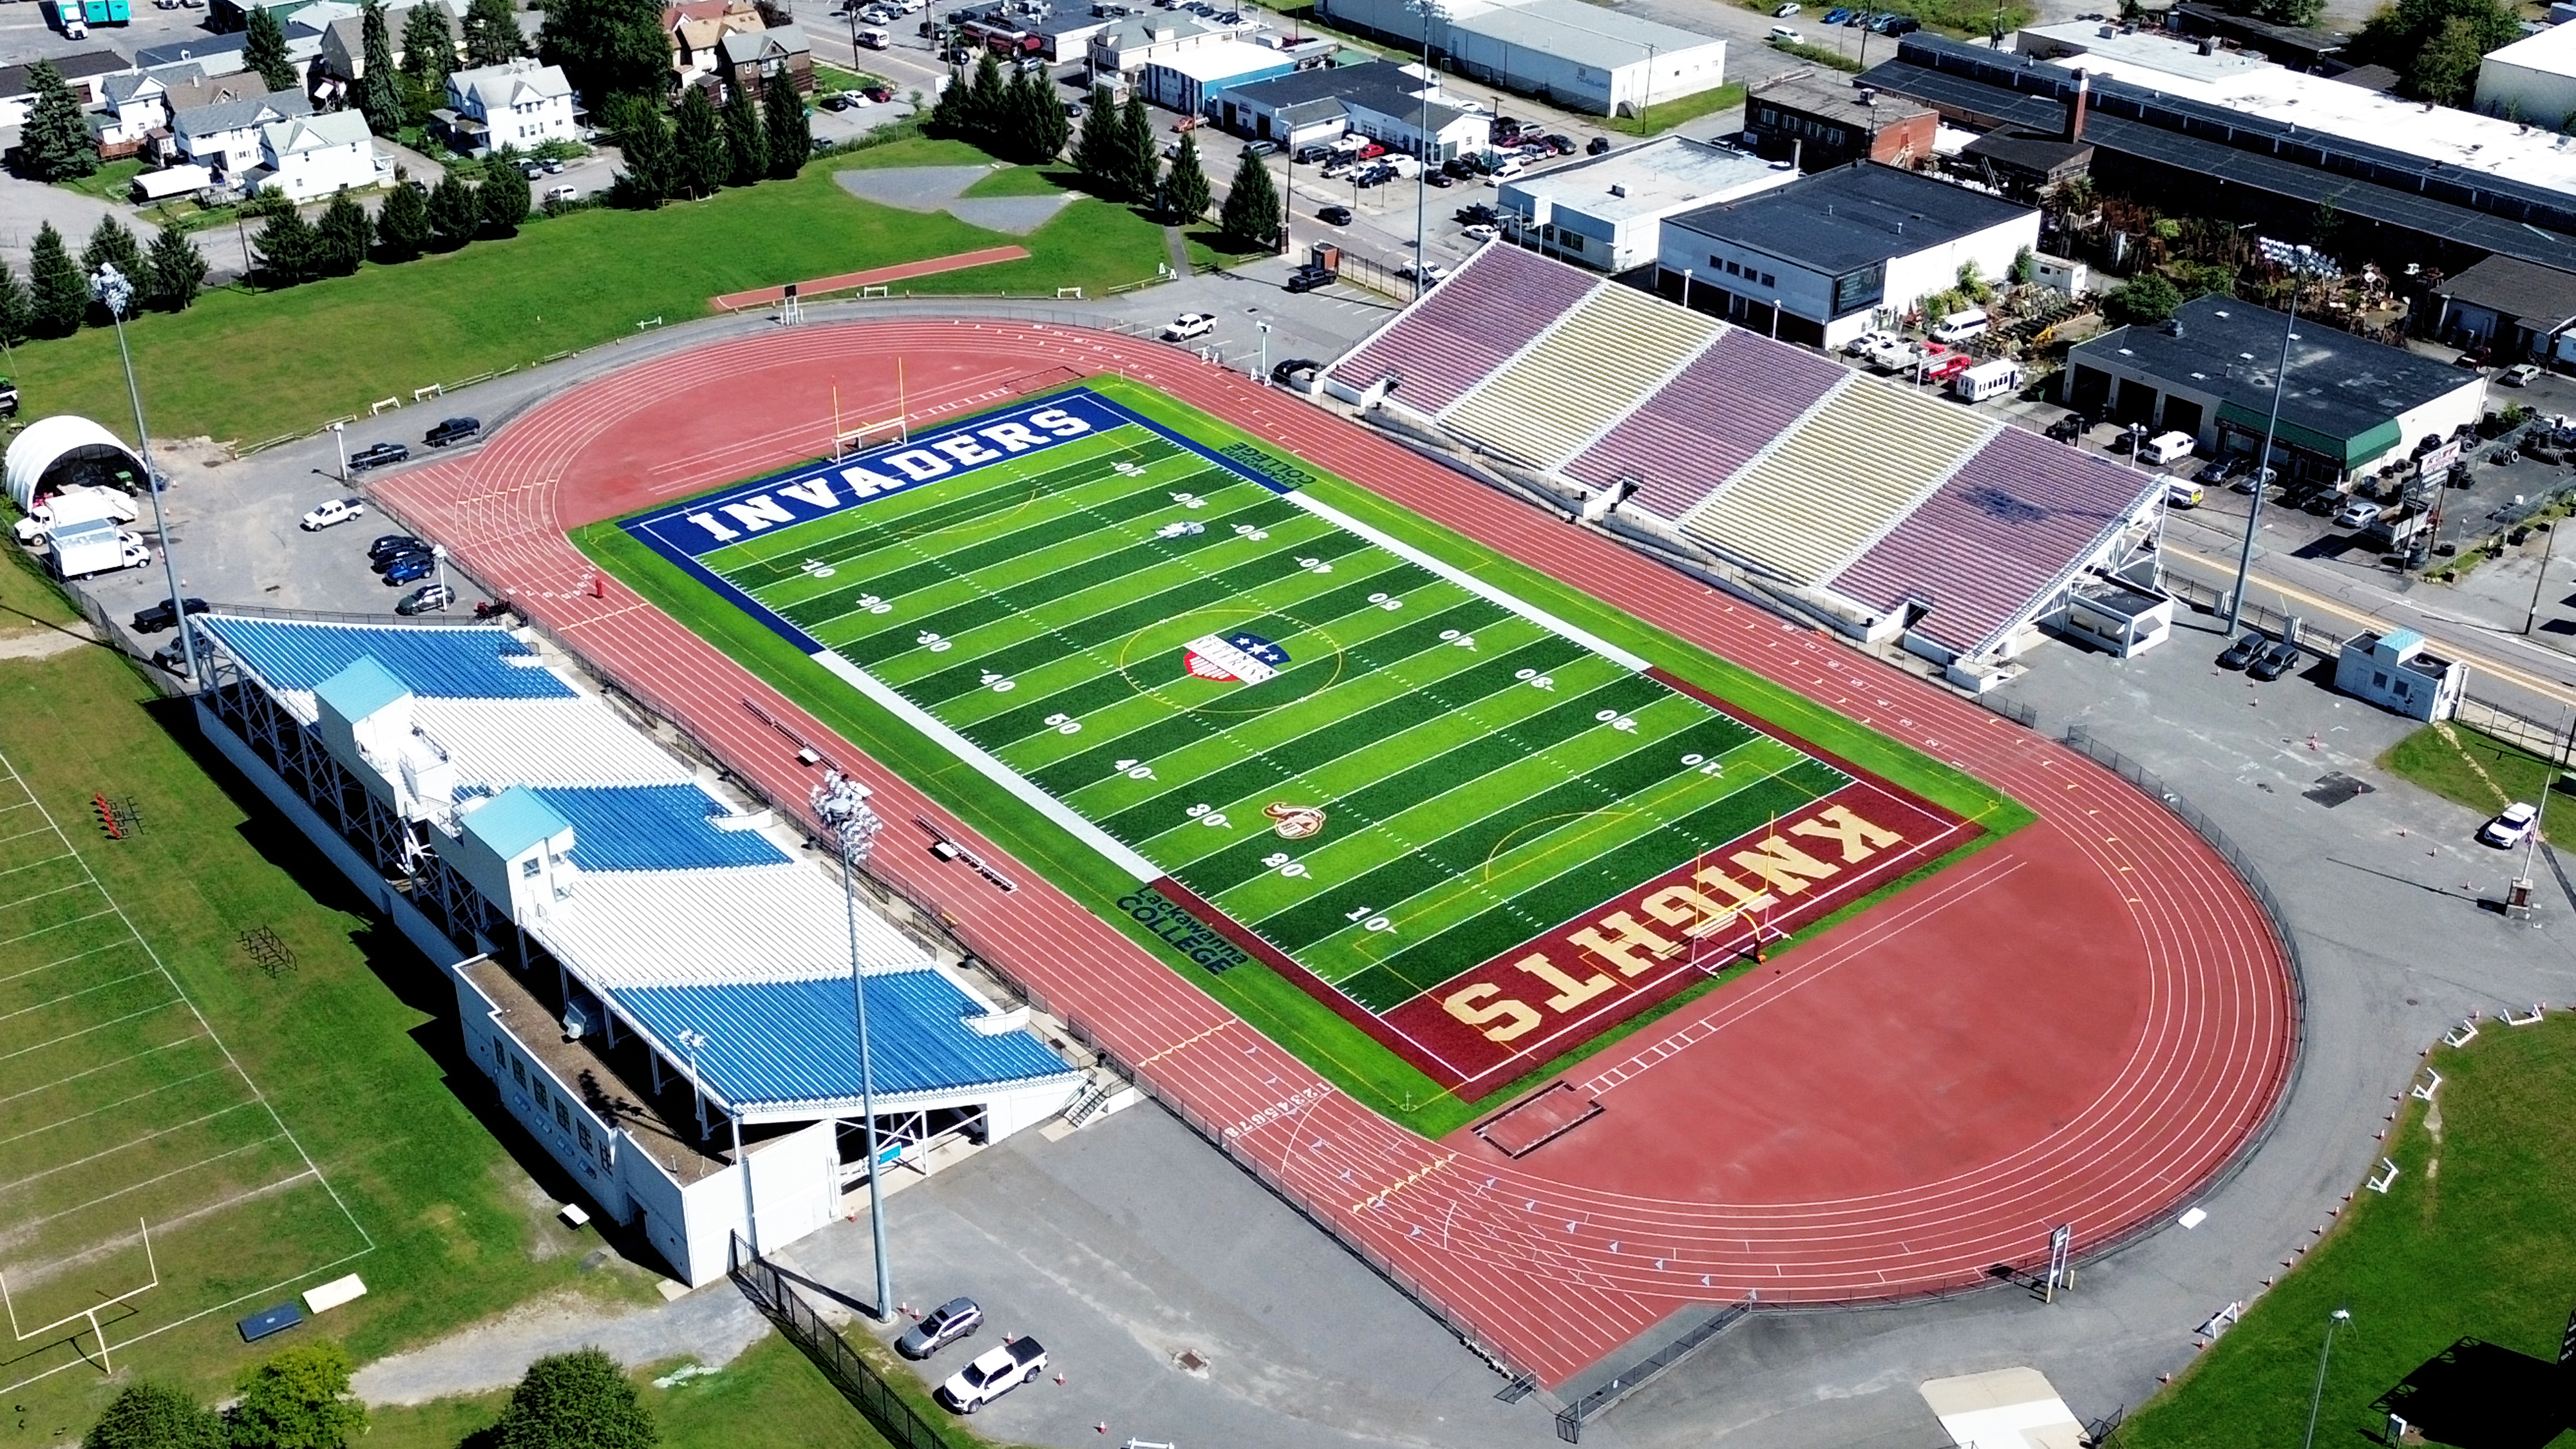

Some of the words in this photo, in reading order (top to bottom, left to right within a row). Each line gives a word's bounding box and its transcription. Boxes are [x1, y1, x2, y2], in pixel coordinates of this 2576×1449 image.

[1115, 463, 1146, 477] 10
[1229, 442, 1317, 484] COLLEGE
[687, 410, 1092, 541] INVADERS
[1173, 493, 1208, 509] 20
[1235, 525, 1269, 541] 30
[801, 562, 835, 578] 10
[1300, 558, 1333, 573] 40
[856, 596, 893, 613] 20
[1367, 593, 1403, 611] 50
[917, 634, 952, 652] 30
[1439, 630, 1474, 646] 40
[1206, 636, 1275, 676] SCRANTON
[980, 674, 1015, 692] 40
[1515, 668, 1553, 687] 30
[1044, 713, 1081, 734] 50
[1596, 710, 1638, 730] 20
[1114, 759, 1152, 779] 40
[1681, 754, 1723, 774] 10
[1186, 804, 1226, 826] 30
[1261, 853, 1305, 876] 20
[1135, 886, 1248, 964] Lackawanna
[1345, 907, 1390, 931] 10
[1442, 804, 1904, 1042] KNIGHTS
[1117, 896, 1236, 975] COLLEGE
[1239, 1121, 1253, 1132] 7
[1264, 1107, 1279, 1118] 5
[1276, 1101, 1289, 1111] 4
[1290, 1095, 1305, 1104] 3
[1303, 1088, 1318, 1098] 2
[1316, 1082, 1330, 1091] 1
